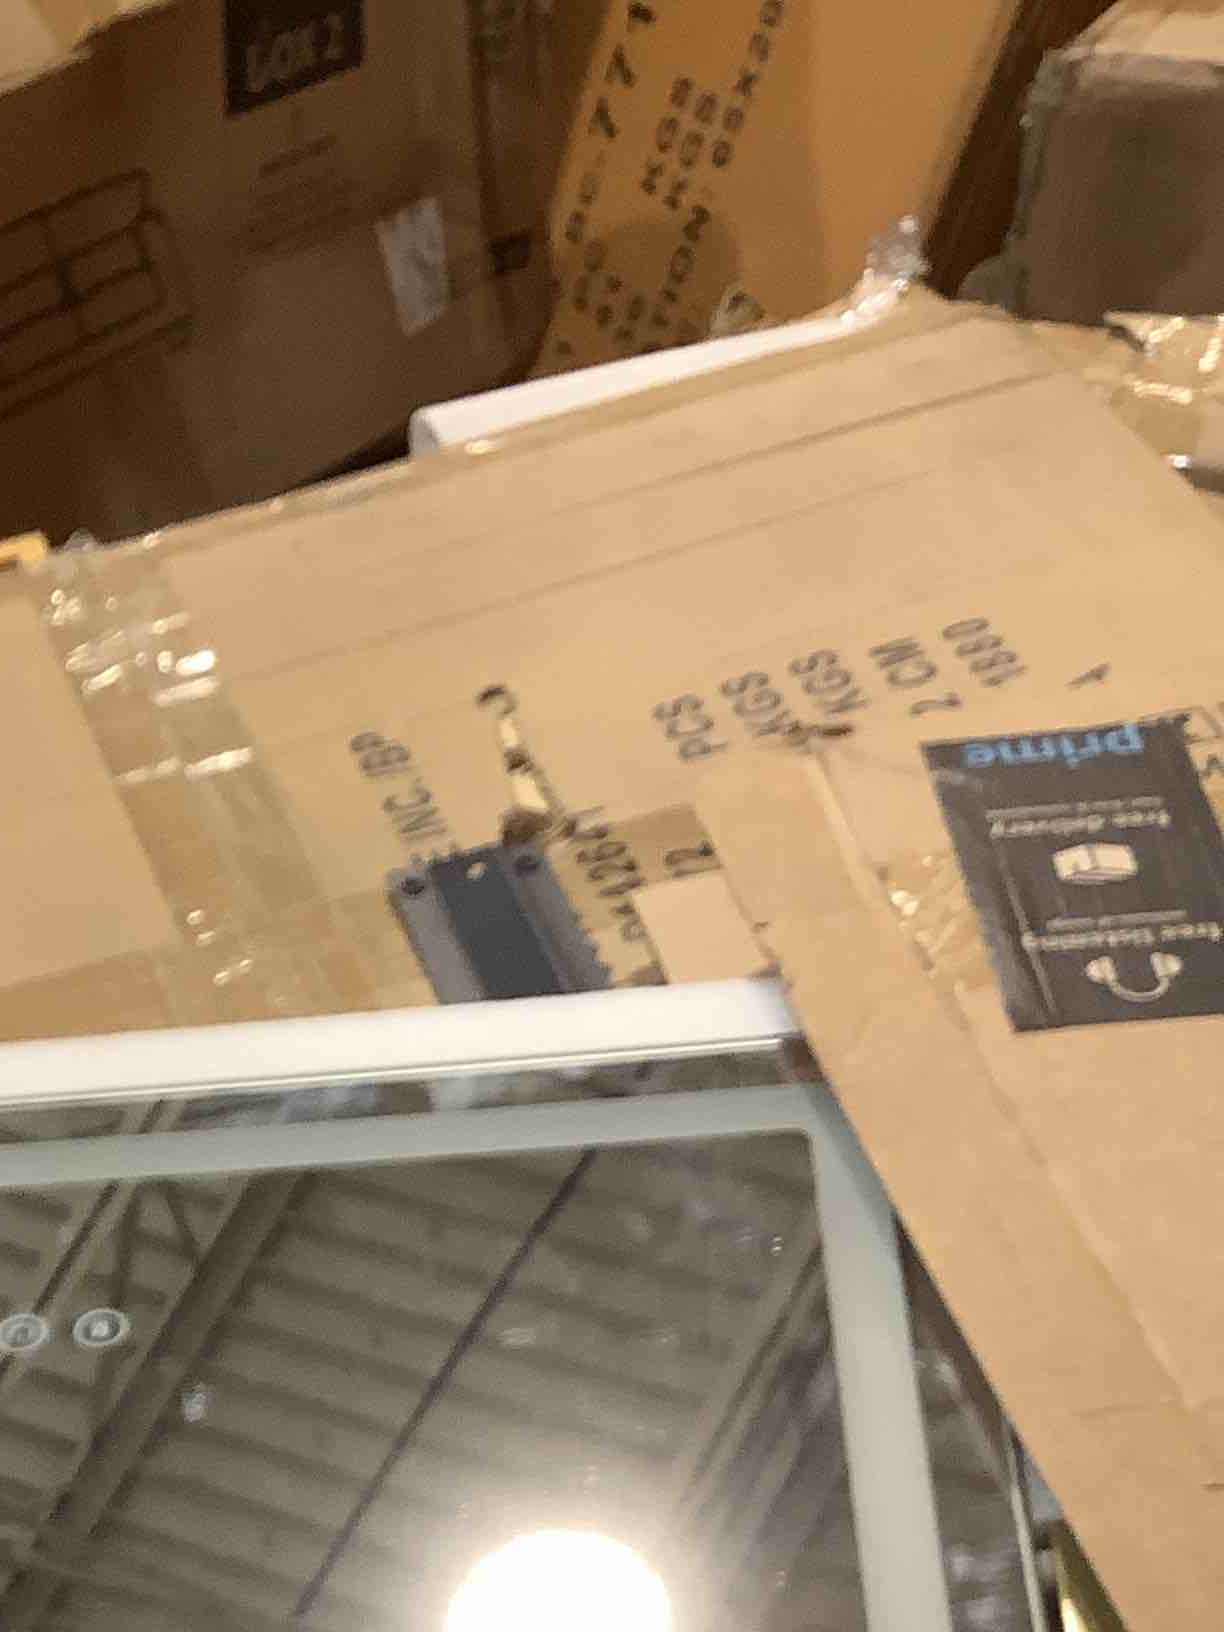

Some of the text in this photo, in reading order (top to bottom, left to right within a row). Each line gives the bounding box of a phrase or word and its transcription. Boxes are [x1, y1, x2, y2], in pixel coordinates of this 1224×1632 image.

[719, 672, 792, 739] KGS
[788, 649, 869, 715] KGS
[652, 694, 728, 764] PCS
[963, 724, 1145, 770] prime
